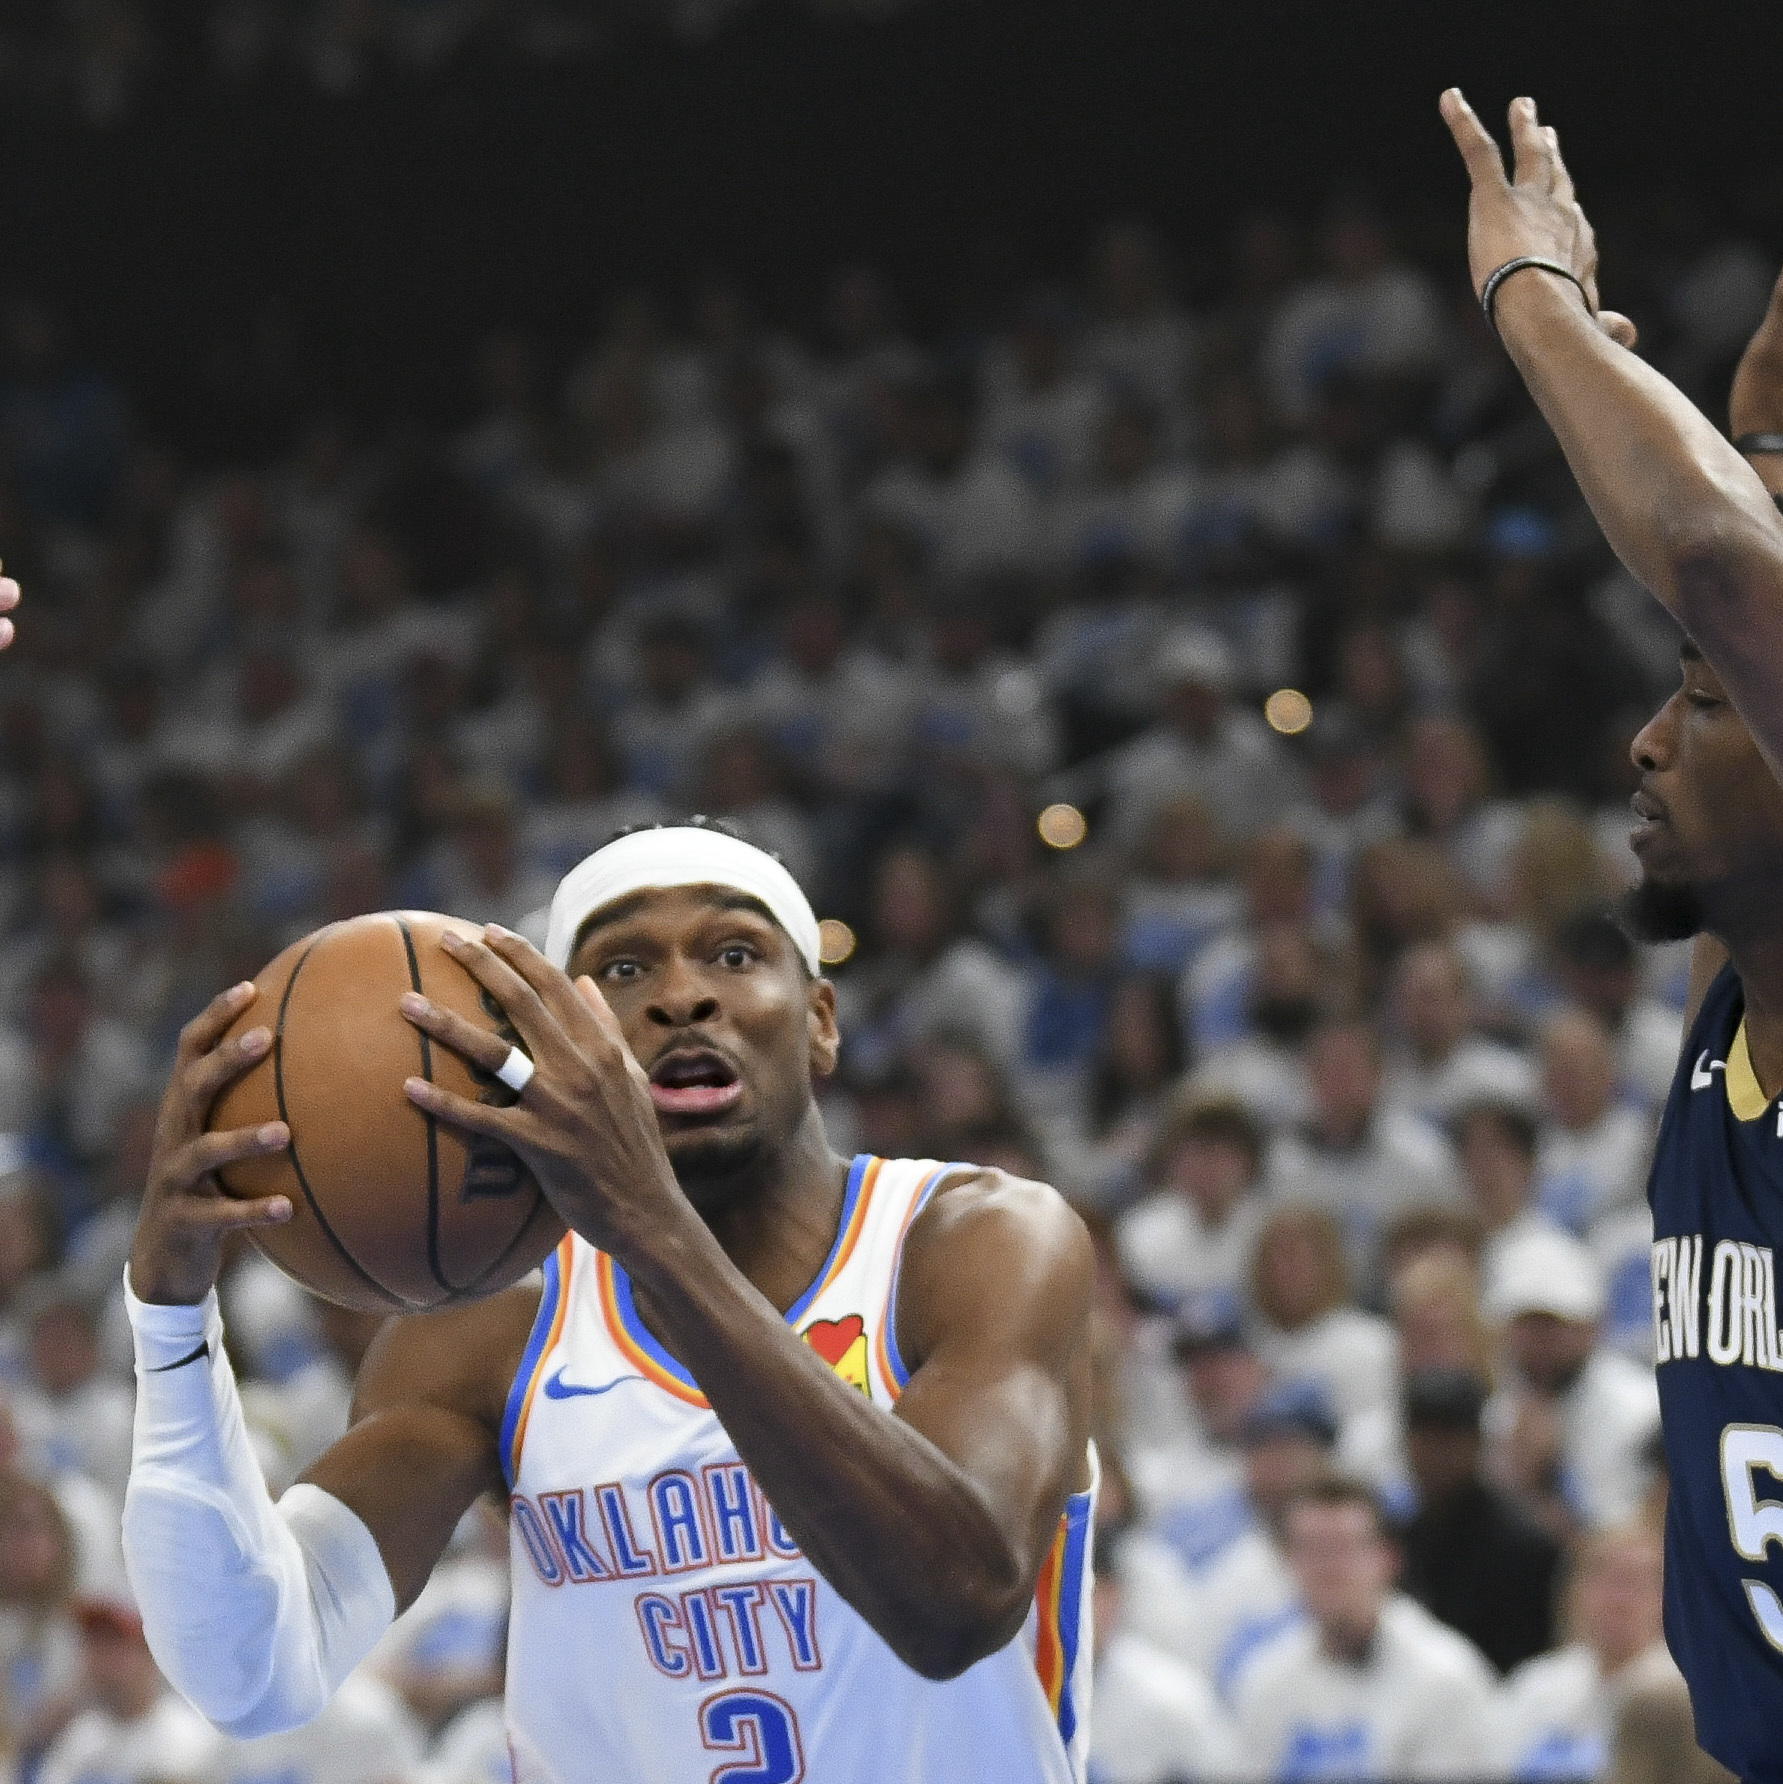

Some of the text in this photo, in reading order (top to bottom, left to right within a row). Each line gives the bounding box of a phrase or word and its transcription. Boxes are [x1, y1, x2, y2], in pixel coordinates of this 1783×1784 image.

[1650, 1232, 1703, 1365] EW
[510, 1461, 803, 1588] OKLAH
[633, 1578, 824, 1682] CITY
